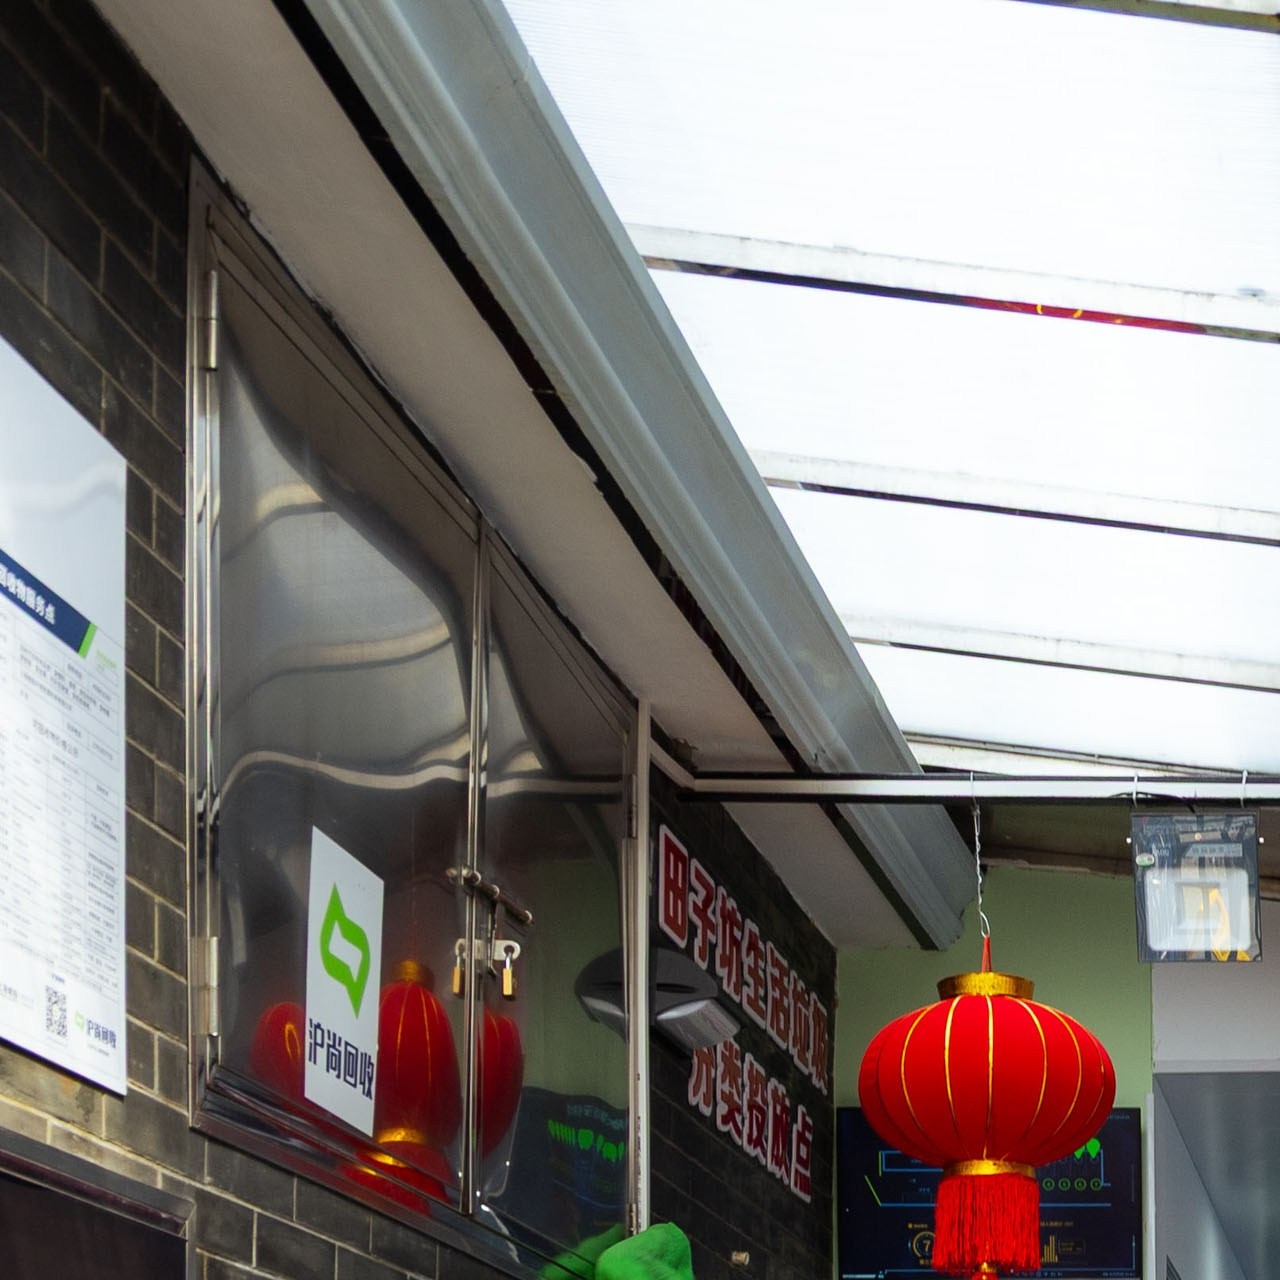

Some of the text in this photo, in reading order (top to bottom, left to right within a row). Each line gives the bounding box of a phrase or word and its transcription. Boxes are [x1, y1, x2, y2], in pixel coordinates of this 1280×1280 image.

[659, 823, 828, 1096] 田子坊生活垃圾
[308, 1018, 374, 1101] 沪尚回收
[688, 1037, 813, 1203] 分类投放点
